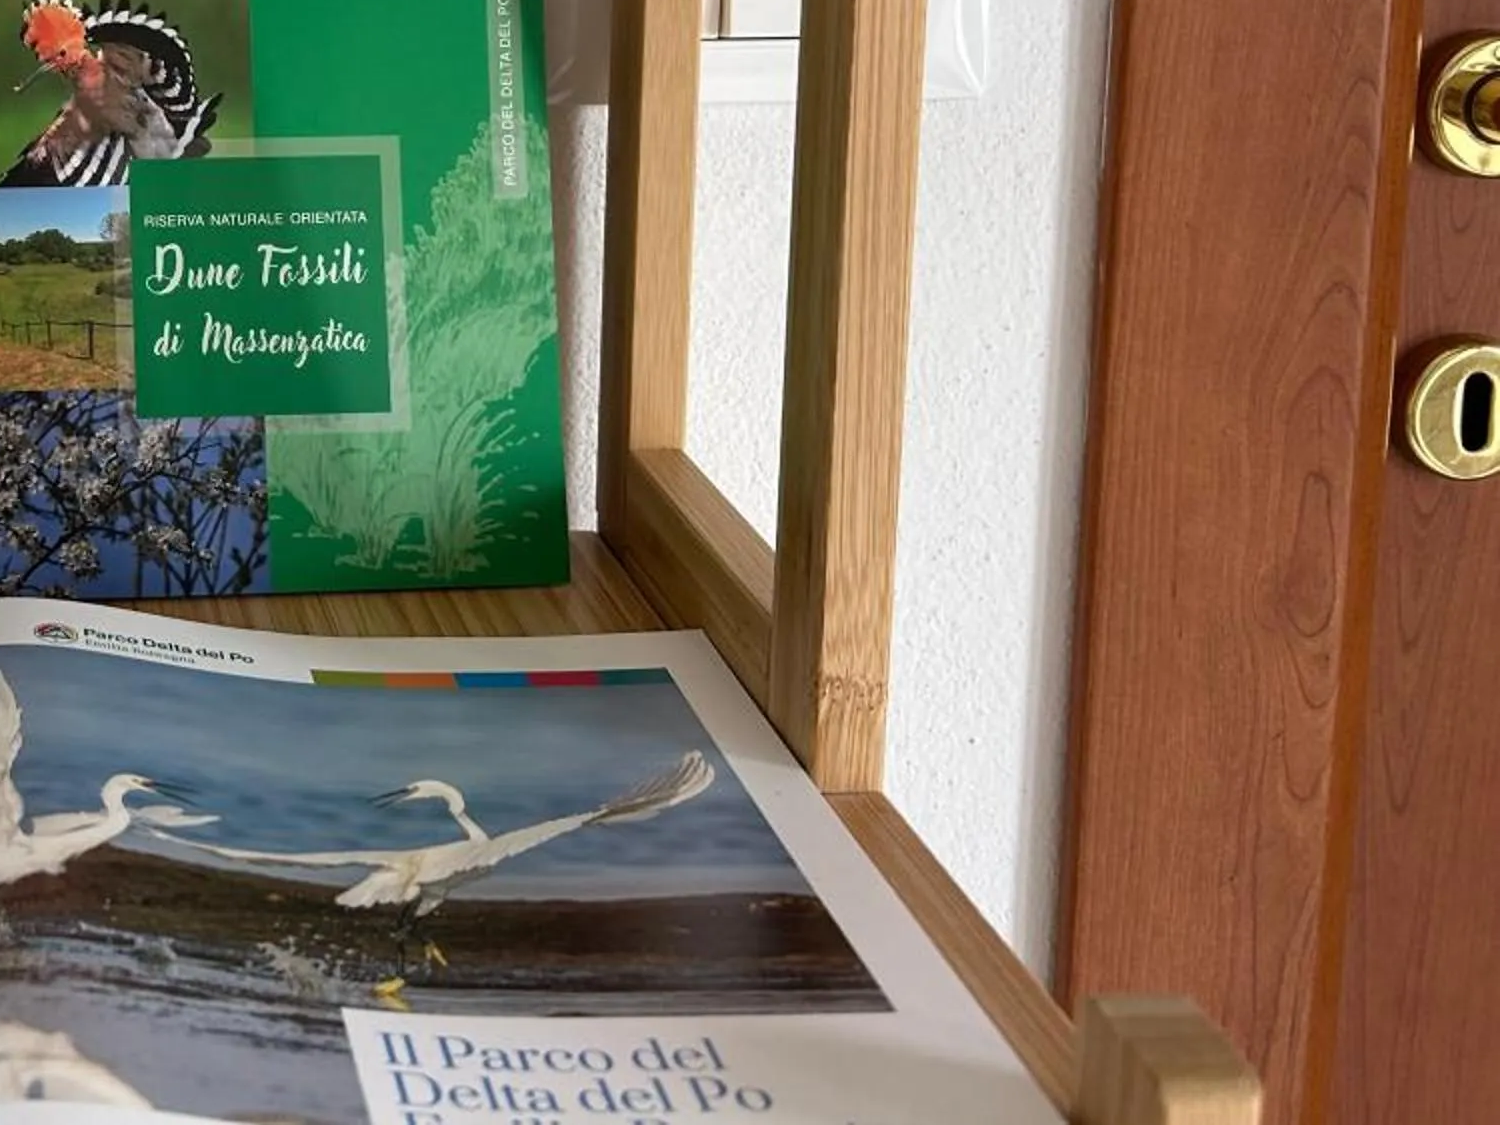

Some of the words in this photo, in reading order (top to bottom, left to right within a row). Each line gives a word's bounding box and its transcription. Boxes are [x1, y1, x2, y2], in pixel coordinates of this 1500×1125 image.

[498, 20, 511, 48] DEL
[500, 52, 513, 97] DELTA
[501, 101, 514, 131] DEL
[502, 135, 517, 186] PARCO
[144, 214, 205, 228] RISERVA
[211, 212, 284, 226] NATURALE
[290, 210, 368, 225] ORIENTATA
[146, 242, 244, 295] Dune
[257, 241, 369, 287] Fossili
[154, 321, 183, 357] di
[202, 312, 370, 368] Massenzatica
[83, 627, 139, 646] Parco
[142, 637, 193, 655] Delta
[195, 647, 225, 660] del
[229, 652, 255, 664] Po
[378, 1031, 420, 1068] Il
[434, 1034, 614, 1072] Parco
[631, 1037, 728, 1072] del
[390, 1070, 564, 1113] Delta
[578, 1077, 678, 1114] del
[685, 1075, 774, 1113] Po
